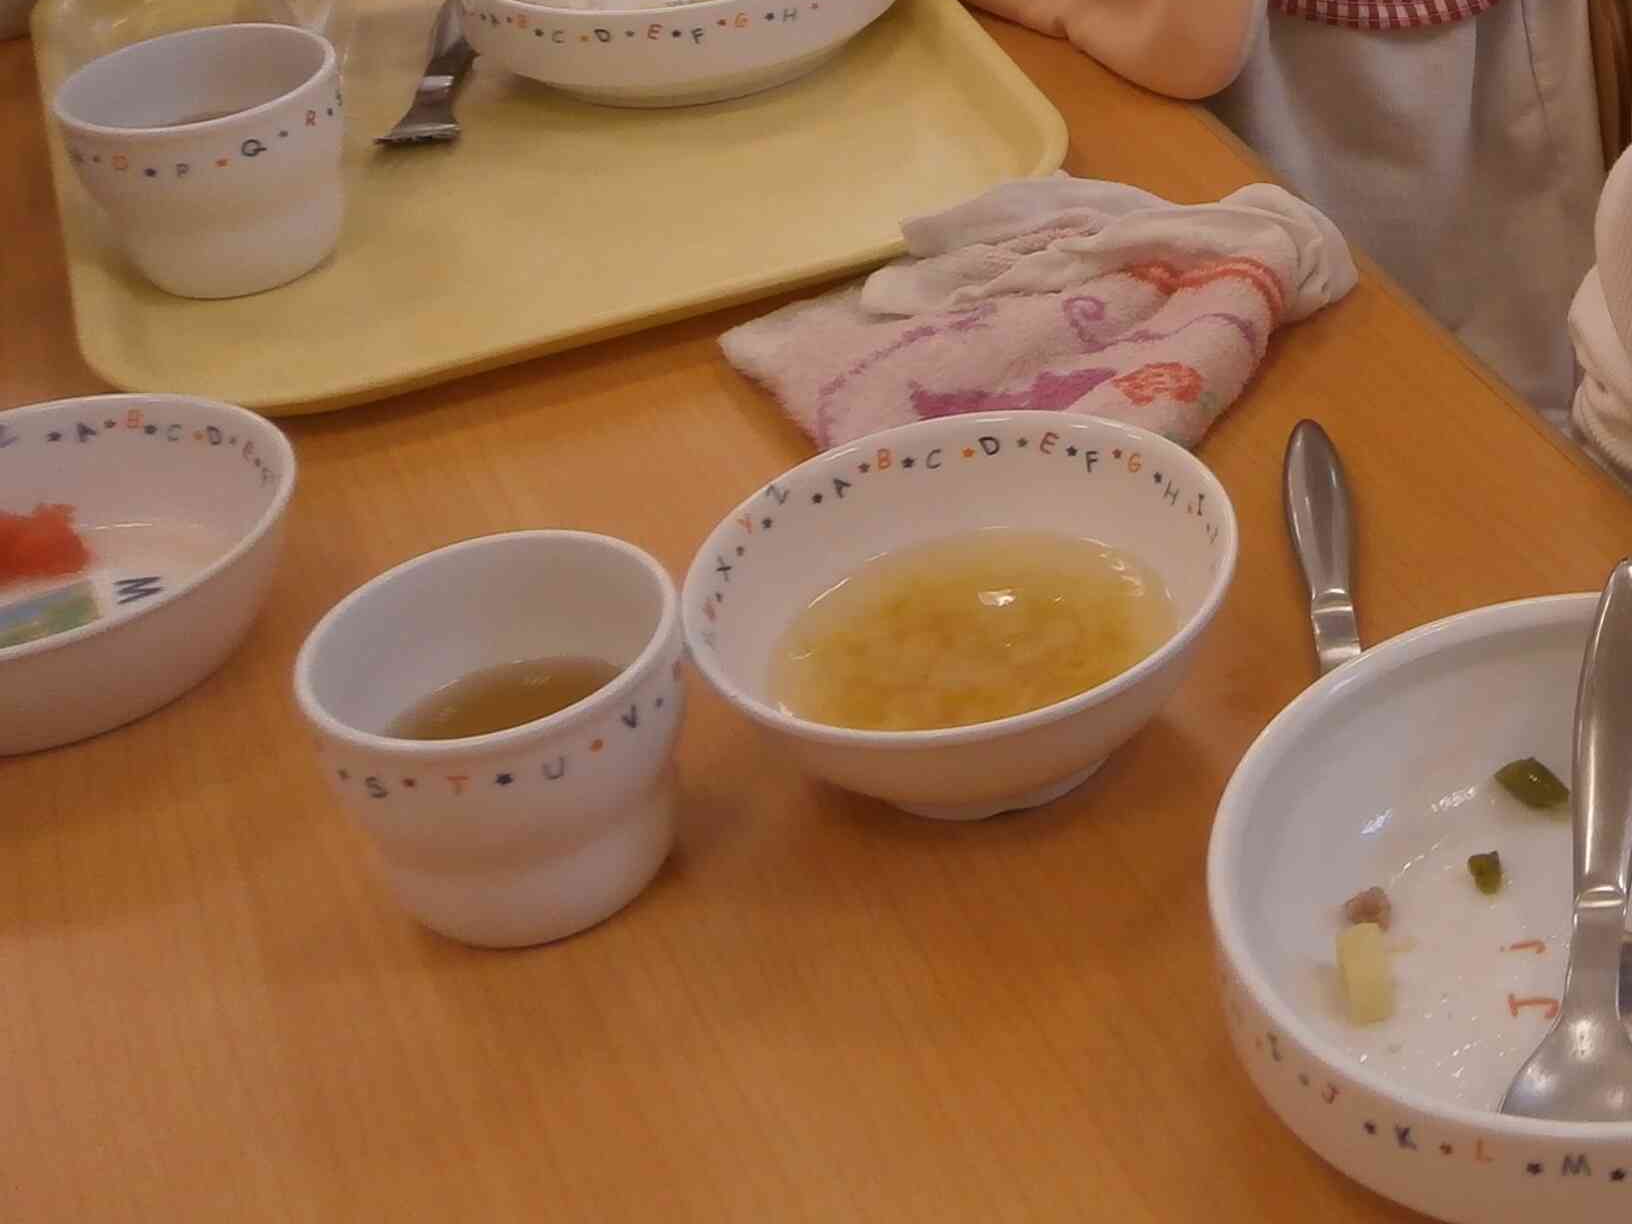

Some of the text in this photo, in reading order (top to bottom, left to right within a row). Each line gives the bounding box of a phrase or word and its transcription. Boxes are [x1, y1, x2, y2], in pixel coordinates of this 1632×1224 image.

[594, 28, 611, 43] D
[647, 24, 663, 40] E
[691, 27, 704, 44] F
[241, 138, 267, 157] Q
[206, 425, 222, 446] D
[833, 477, 852, 498] A
[876, 448, 892, 471] B
[926, 449, 943, 469] C
[978, 436, 1001, 456] D
[1040, 432, 1060, 455] E
[1085, 450, 1099, 473] F
[1127, 453, 1142, 473] G
[1163, 480, 1181, 506] H
[365, 777, 389, 799] S
[543, 756, 566, 781] U
[1474, 1138, 1495, 1162] L
[1561, 1153, 1592, 1177] M
